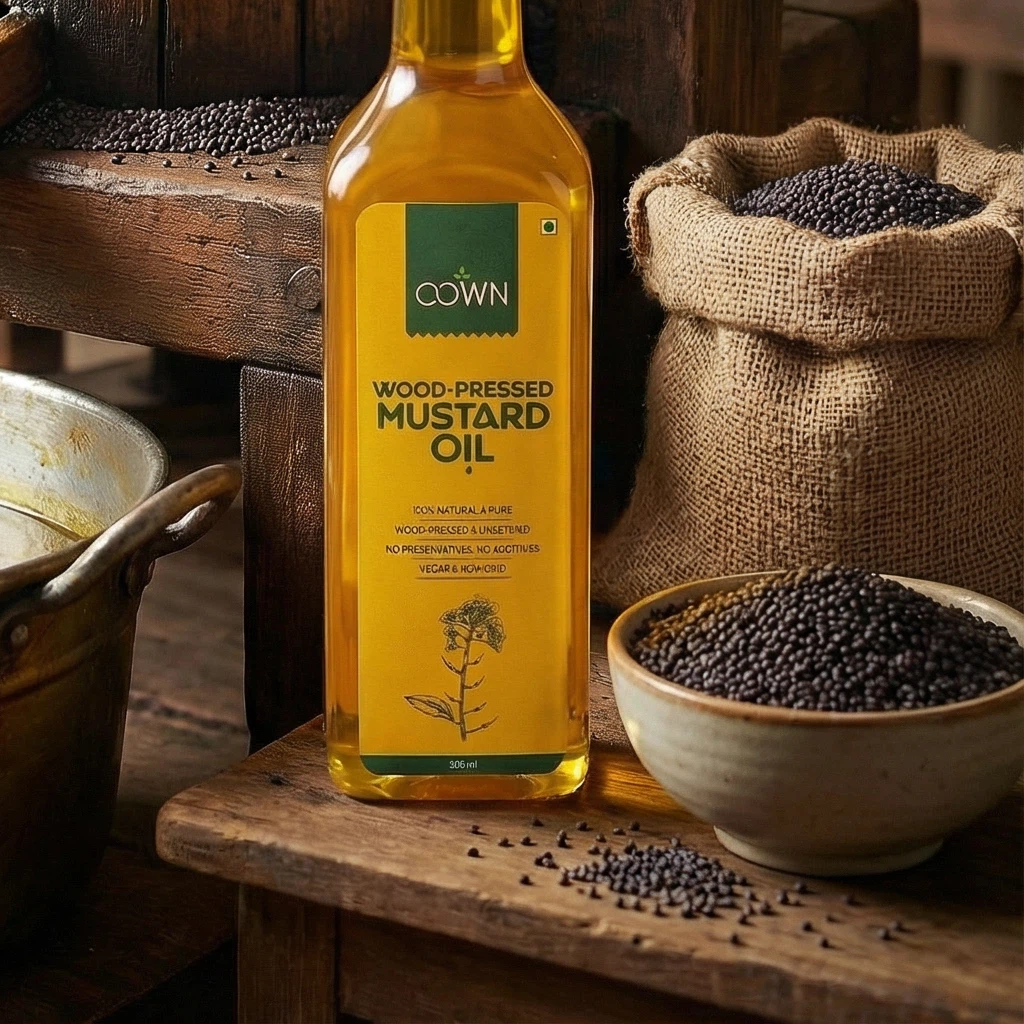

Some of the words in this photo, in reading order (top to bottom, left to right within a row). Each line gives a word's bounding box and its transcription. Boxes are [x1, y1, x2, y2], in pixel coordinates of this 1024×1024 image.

[372, 380, 554, 398] WOOD-PRESSED
[377, 402, 551, 430] MUSTARD
[430, 433, 495, 462] OIL
[488, 505, 513, 515] PURE
[385, 545, 400, 554] NO
